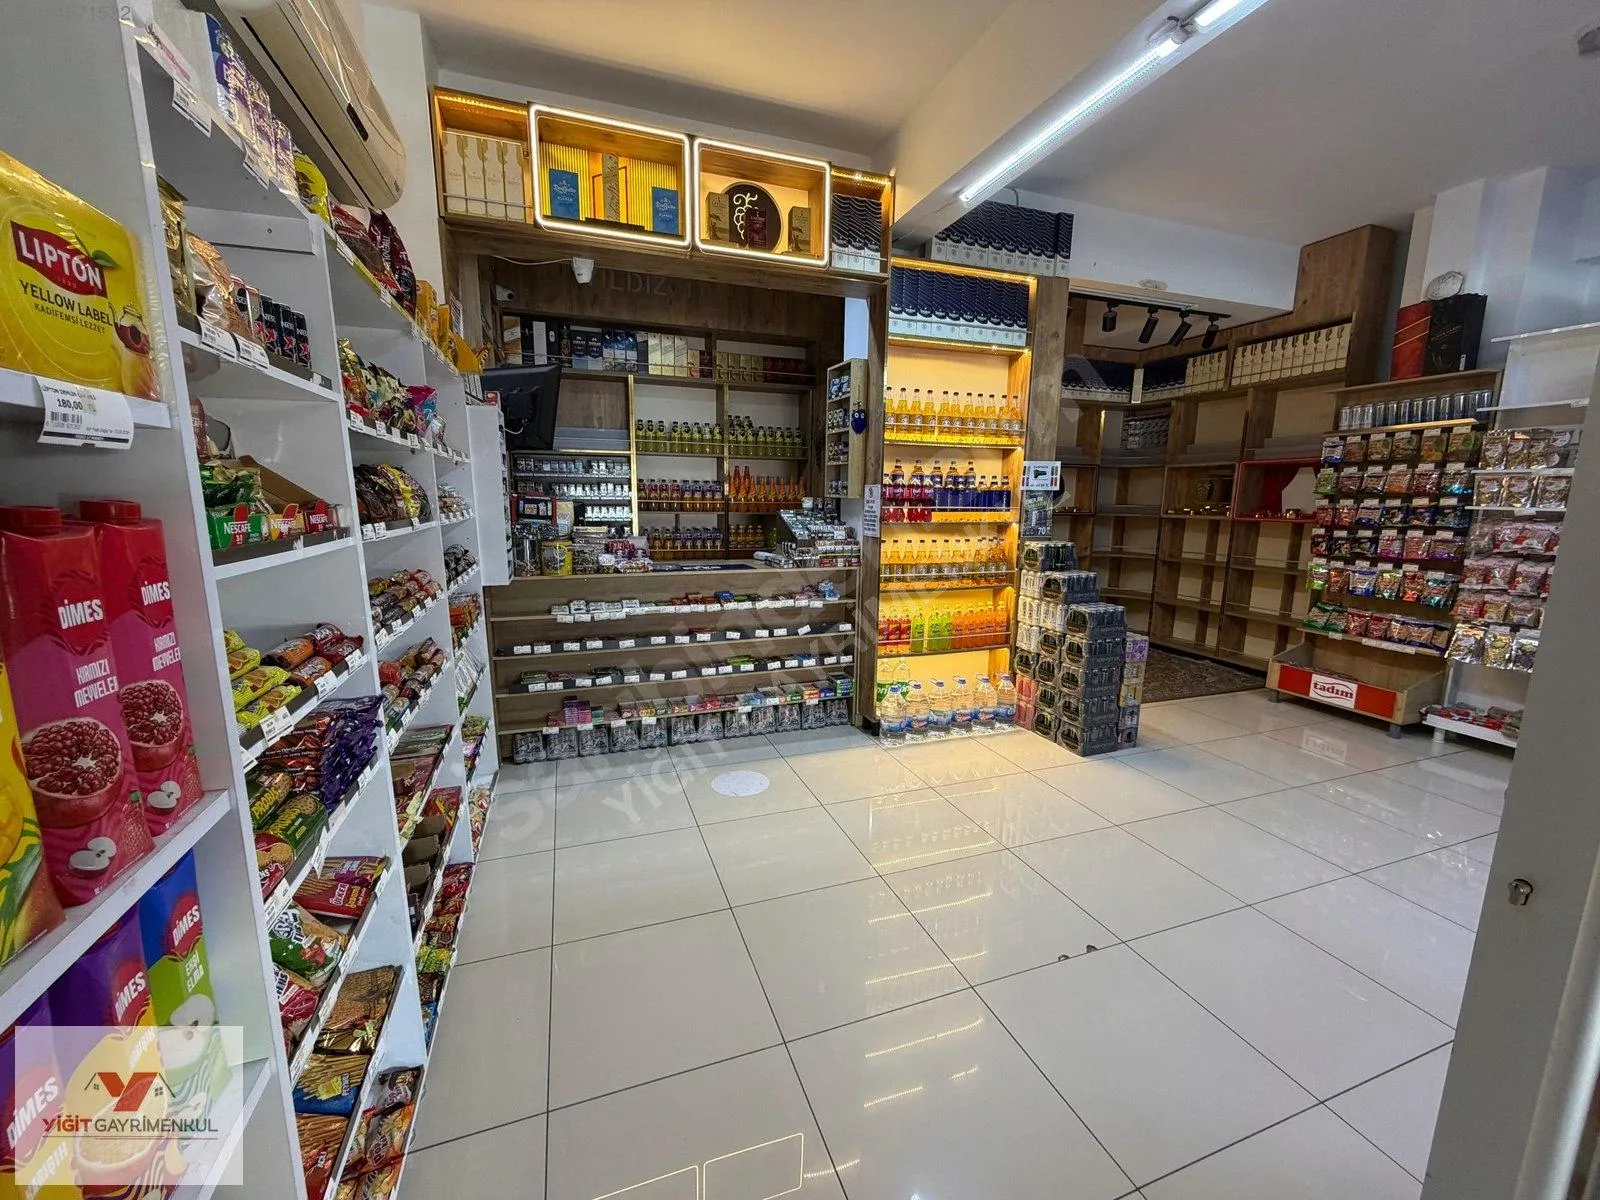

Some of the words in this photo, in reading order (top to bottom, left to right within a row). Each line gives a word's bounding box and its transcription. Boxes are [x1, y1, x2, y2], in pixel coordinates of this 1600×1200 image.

[18, 231, 102, 291] LIPTON
[19, 279, 75, 312] YELLOW
[78, 303, 114, 327] LABEL
[34, 303, 79, 325] KADİFEMSİ
[80, 321, 106, 335] LEZZET
[57, 398, 83, 411] 180,00
[140, 580, 171, 606] DİMES
[57, 598, 103, 630] DİMES
[75, 658, 110, 685] KIRMIZI
[1312, 682, 1354, 699] tadım
[172, 904, 200, 947] DİMES
[115, 971, 146, 1023] DİMES
[5, 1076, 60, 1150] DİMES
